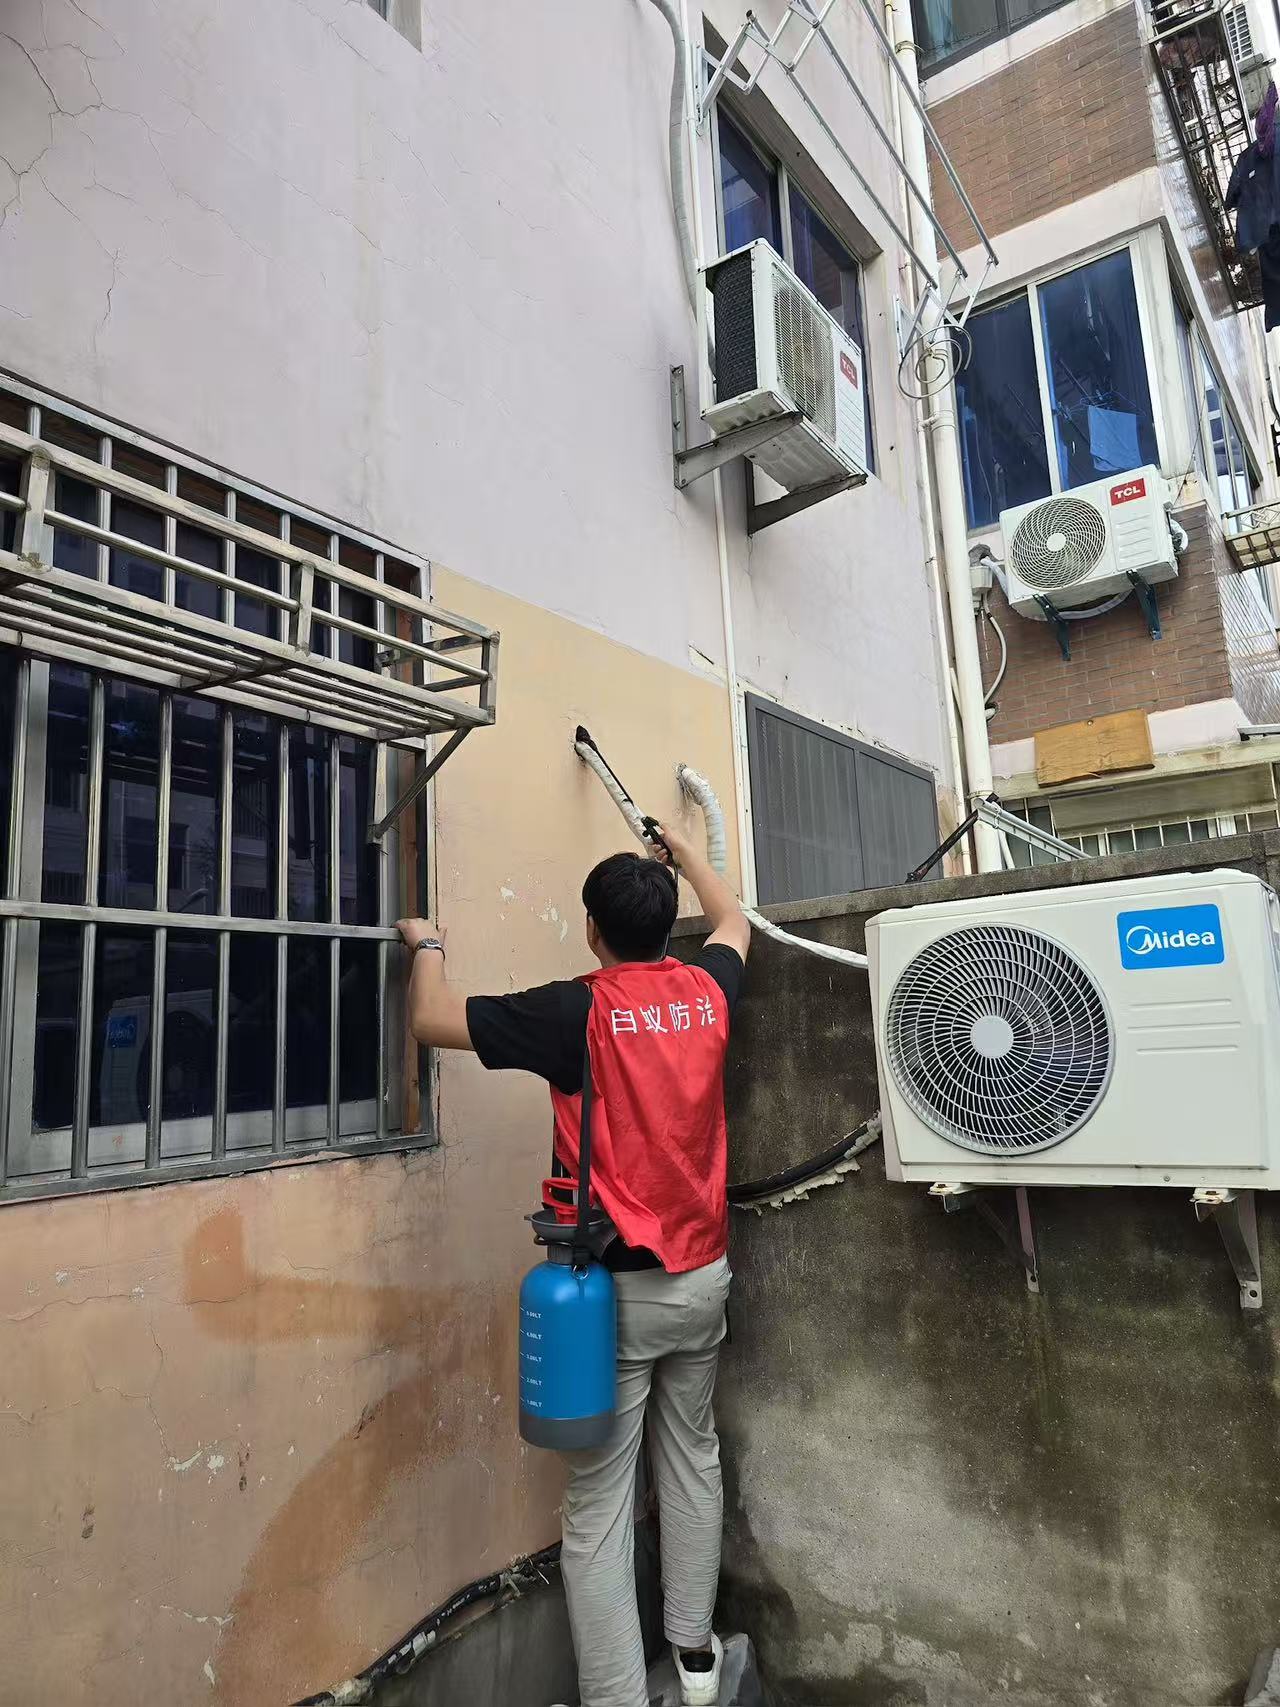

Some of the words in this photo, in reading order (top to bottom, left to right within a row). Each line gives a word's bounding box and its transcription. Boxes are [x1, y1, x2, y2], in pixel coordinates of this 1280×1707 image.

[841, 358, 855, 380] TCL
[1114, 485, 1141, 499] TCL
[1126, 925, 1216, 955] Midea
